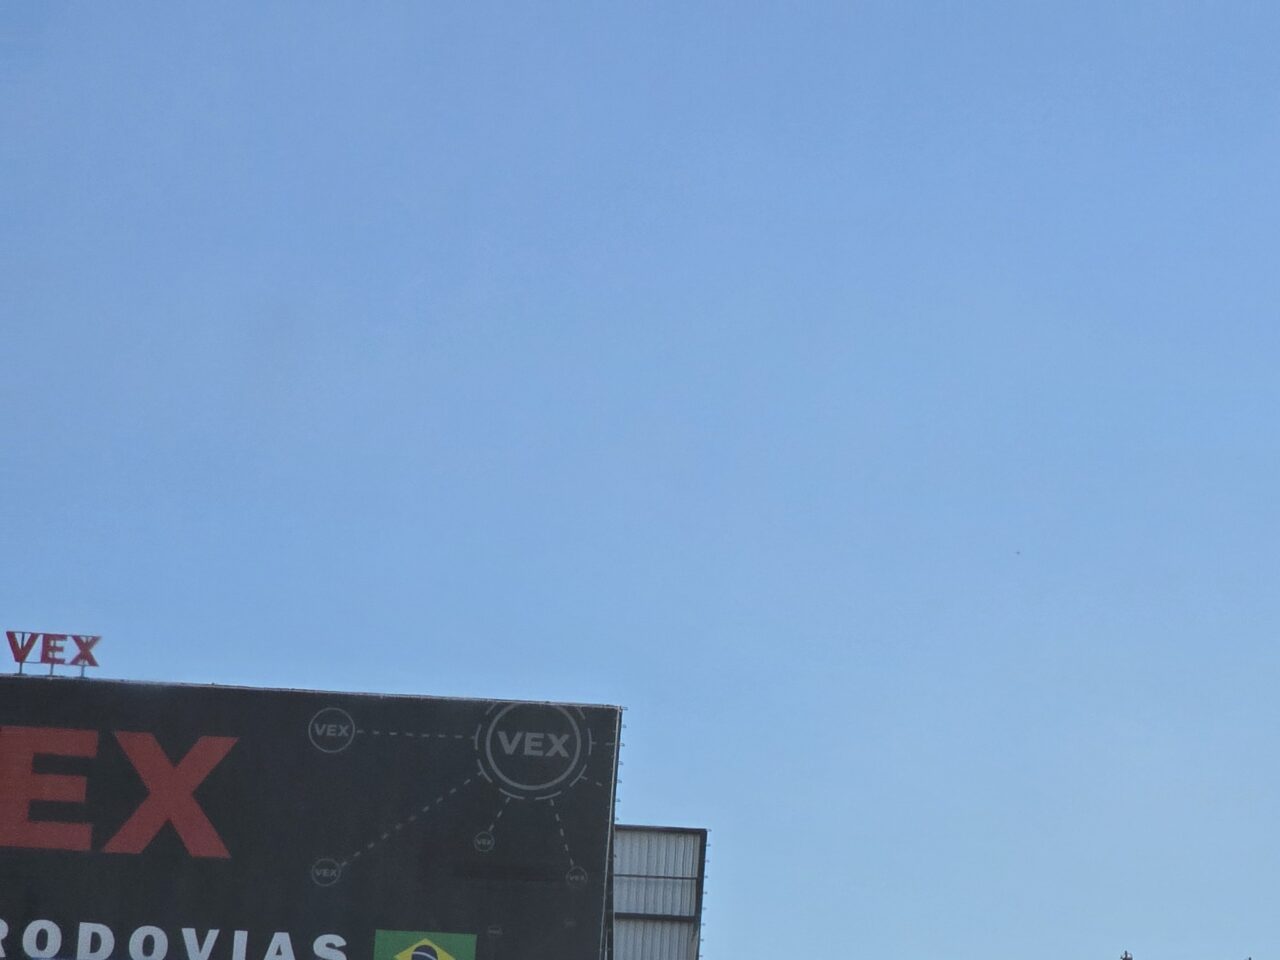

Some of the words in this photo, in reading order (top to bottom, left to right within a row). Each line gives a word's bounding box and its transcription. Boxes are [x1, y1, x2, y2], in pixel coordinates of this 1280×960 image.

[6, 631, 101, 667] VEX
[315, 723, 349, 738] VEX
[498, 731, 571, 758] VEX
[314, 868, 338, 878] VEX
